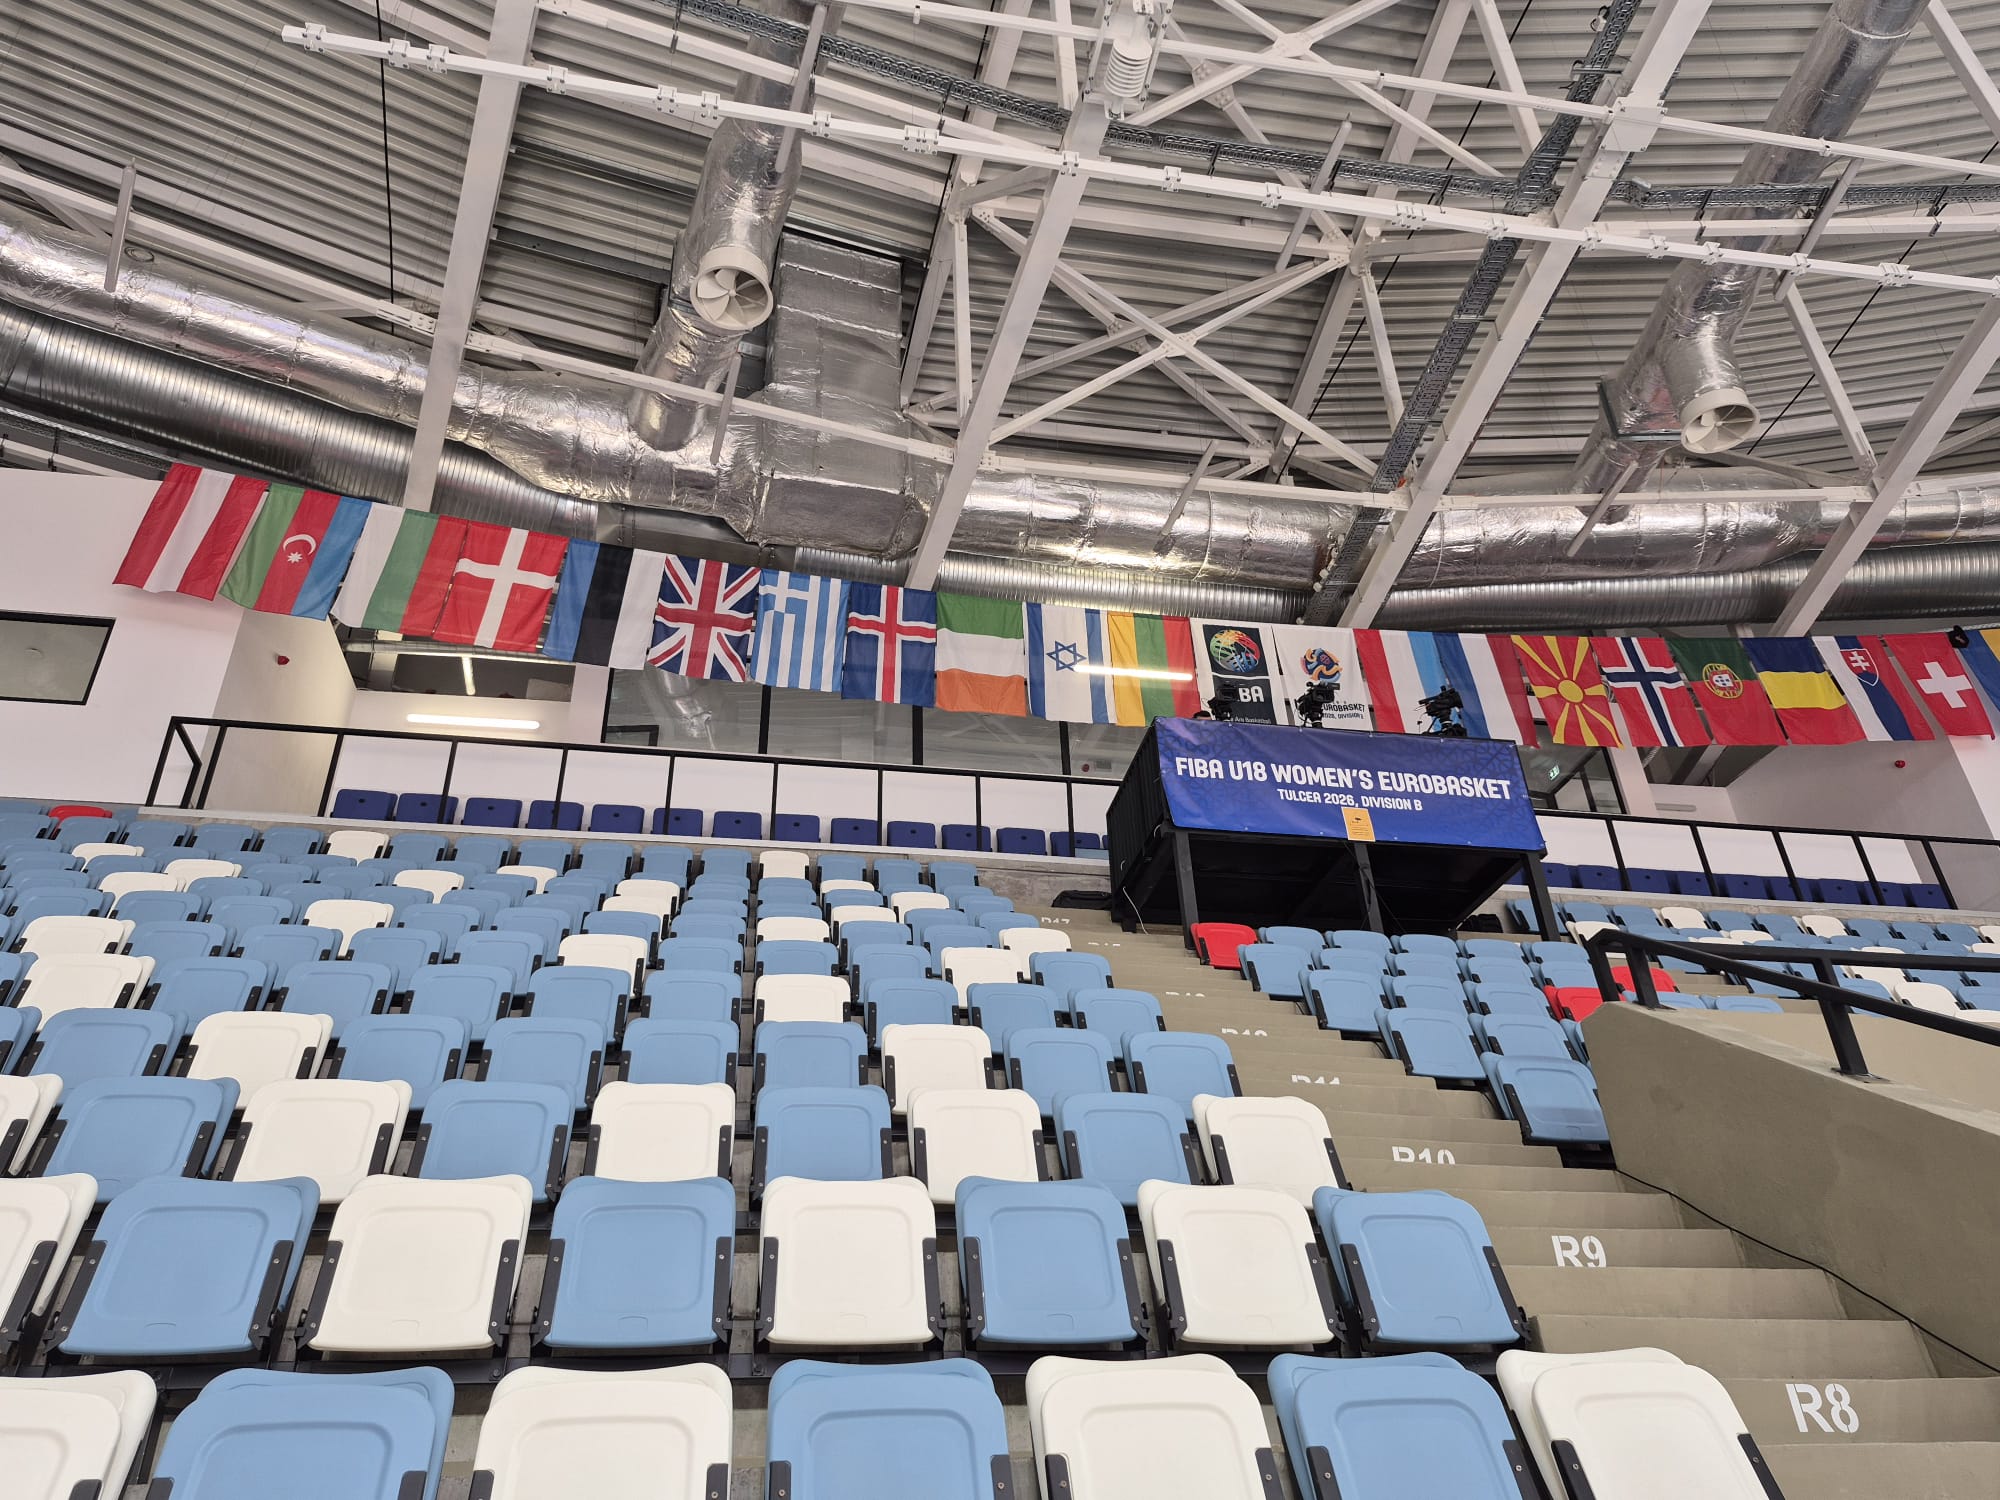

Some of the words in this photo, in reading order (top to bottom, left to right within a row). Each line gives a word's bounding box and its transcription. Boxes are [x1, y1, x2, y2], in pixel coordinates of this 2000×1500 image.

[1238, 685, 1265, 703] BA
[1322, 703, 1365, 712] UROBASKET
[1175, 757, 1224, 779] FIBA
[1228, 760, 1268, 782] U18
[1270, 763, 1374, 790] WOMEN'S
[1377, 771, 1511, 800] EUROBASKET
[1276, 788, 1322, 803] TULCEA
[1324, 793, 1359, 808] 2026,
[1361, 795, 1412, 811] DIVISION
[1413, 799, 1423, 811] B
[1551, 1235, 1607, 1268] R9
[1785, 1383, 1859, 1433] R8
